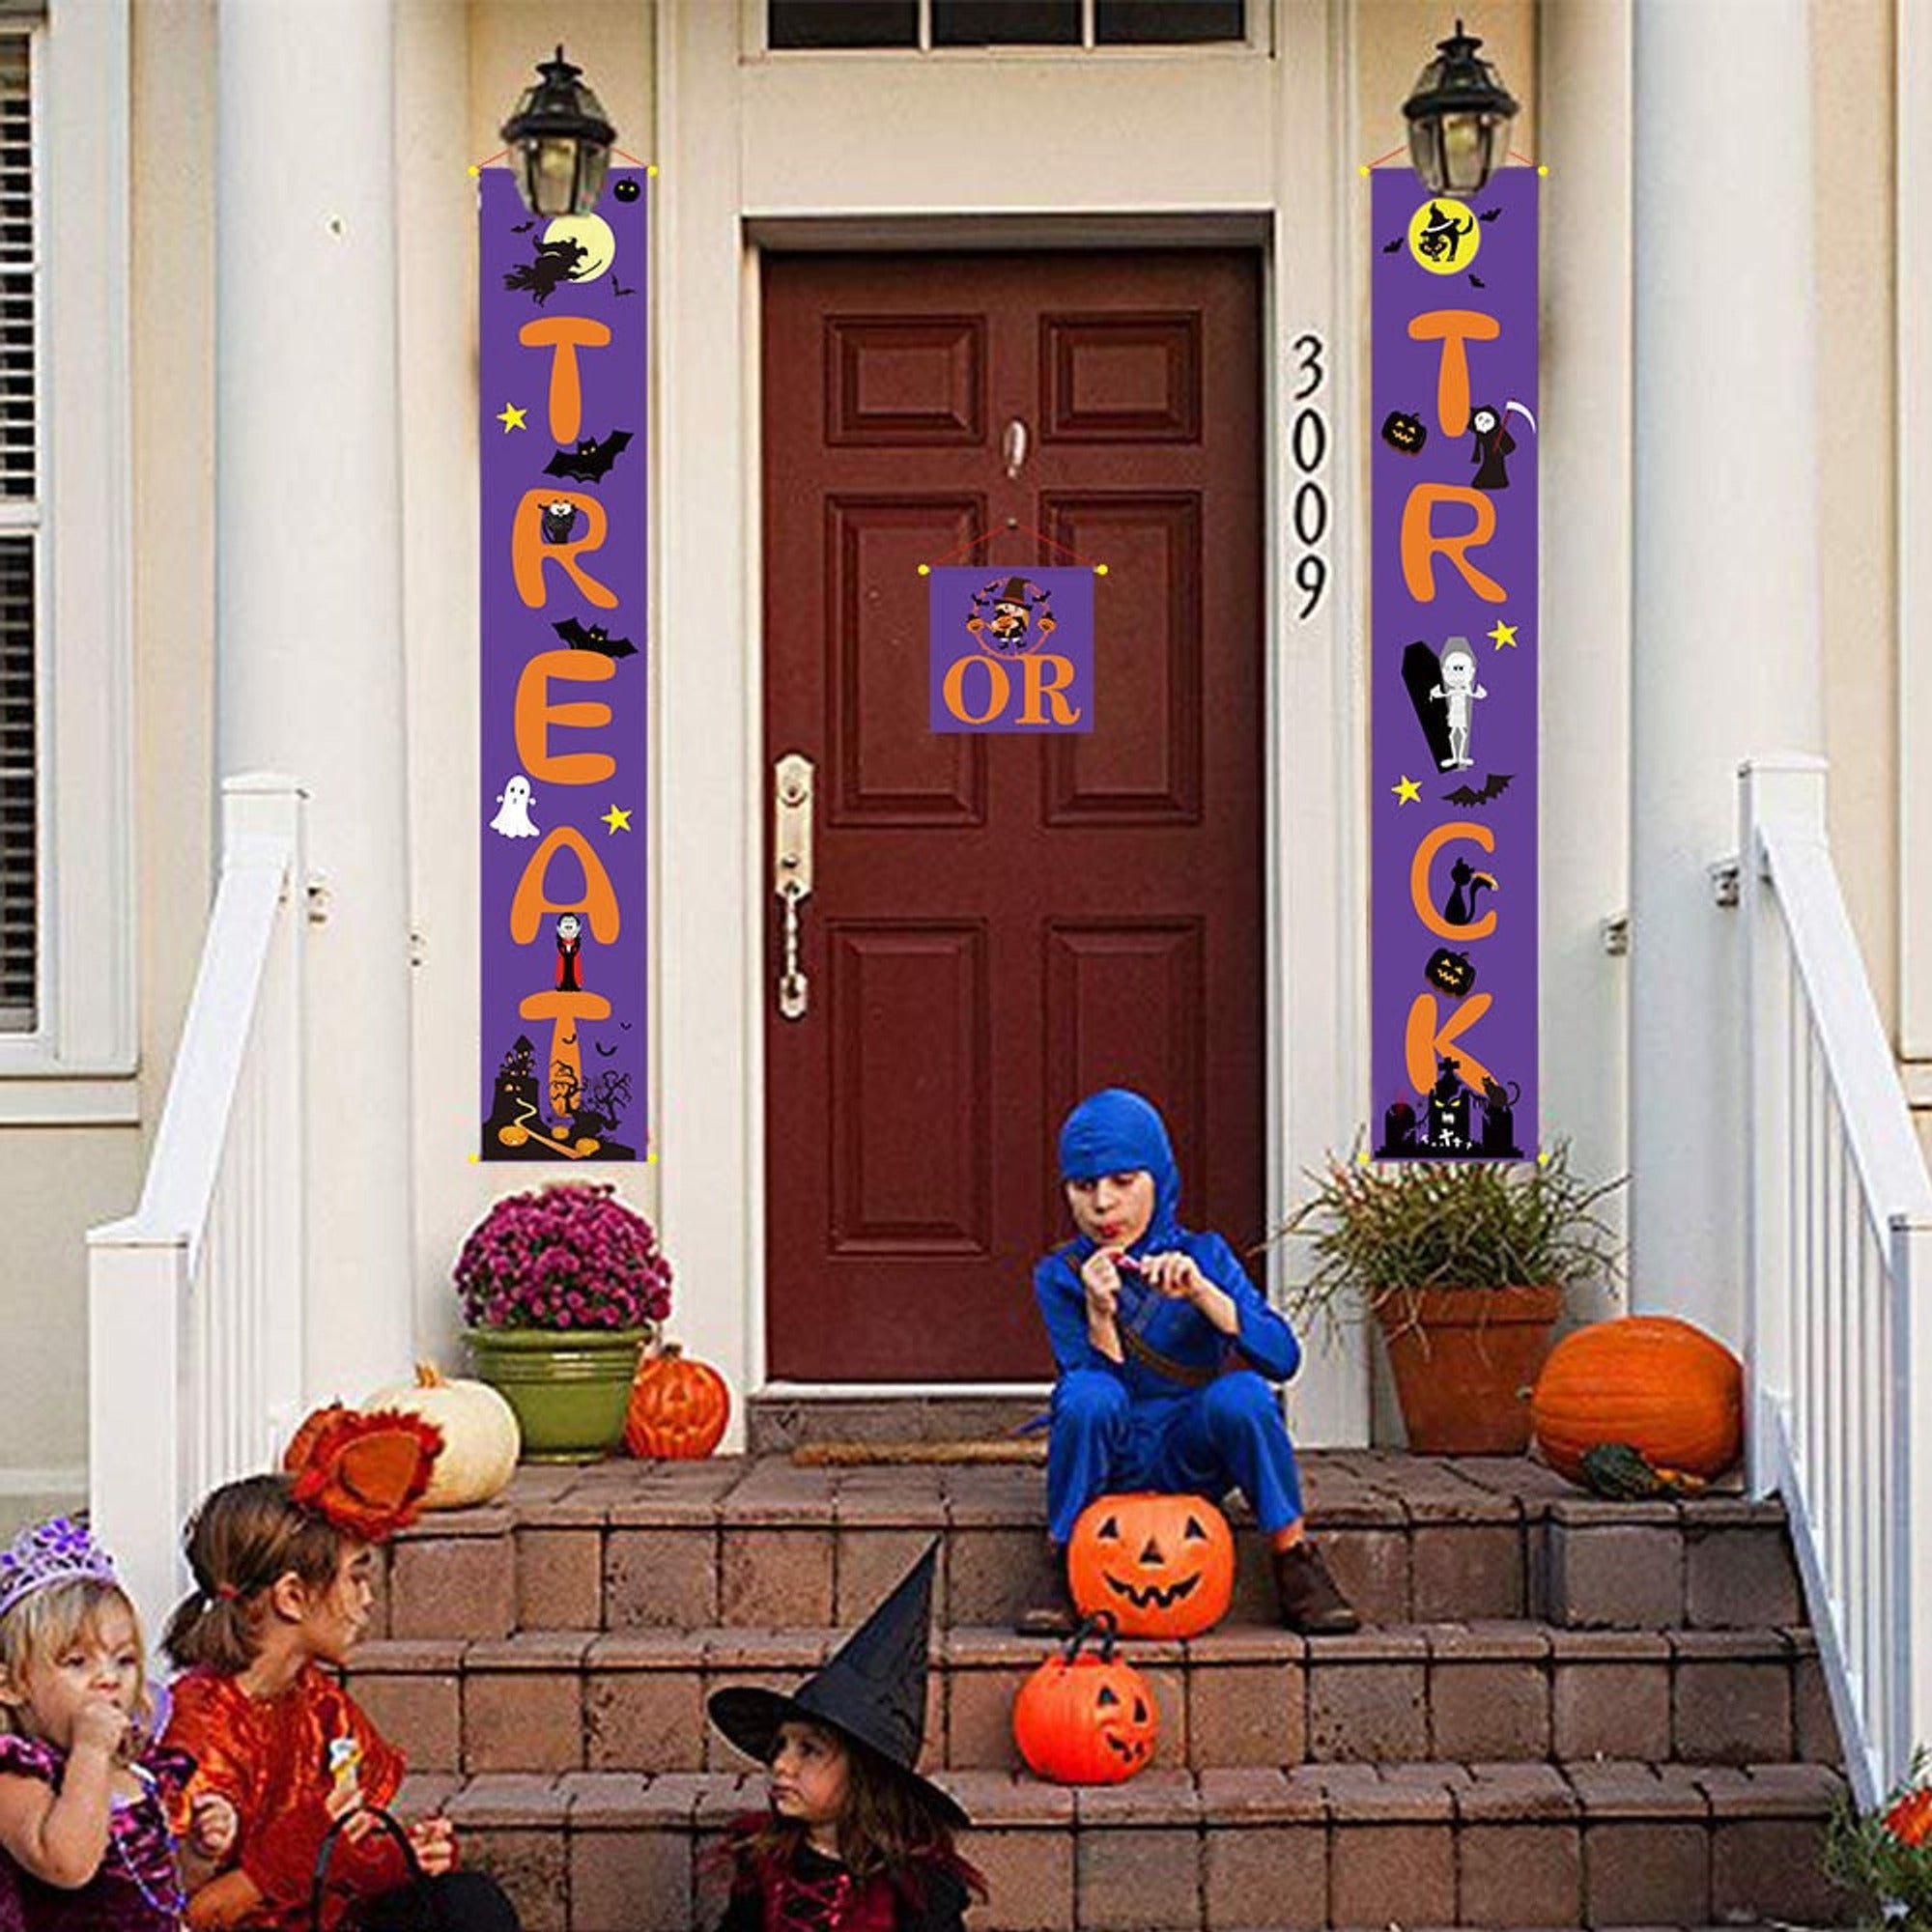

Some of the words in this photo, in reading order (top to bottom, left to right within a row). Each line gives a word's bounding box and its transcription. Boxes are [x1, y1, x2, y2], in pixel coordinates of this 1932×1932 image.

[510, 316, 619, 1119] TREAT
[943, 654, 1081, 724] OR
[1293, 335, 1326, 619] 3009
[1402, 309, 1506, 1096] TRCK
